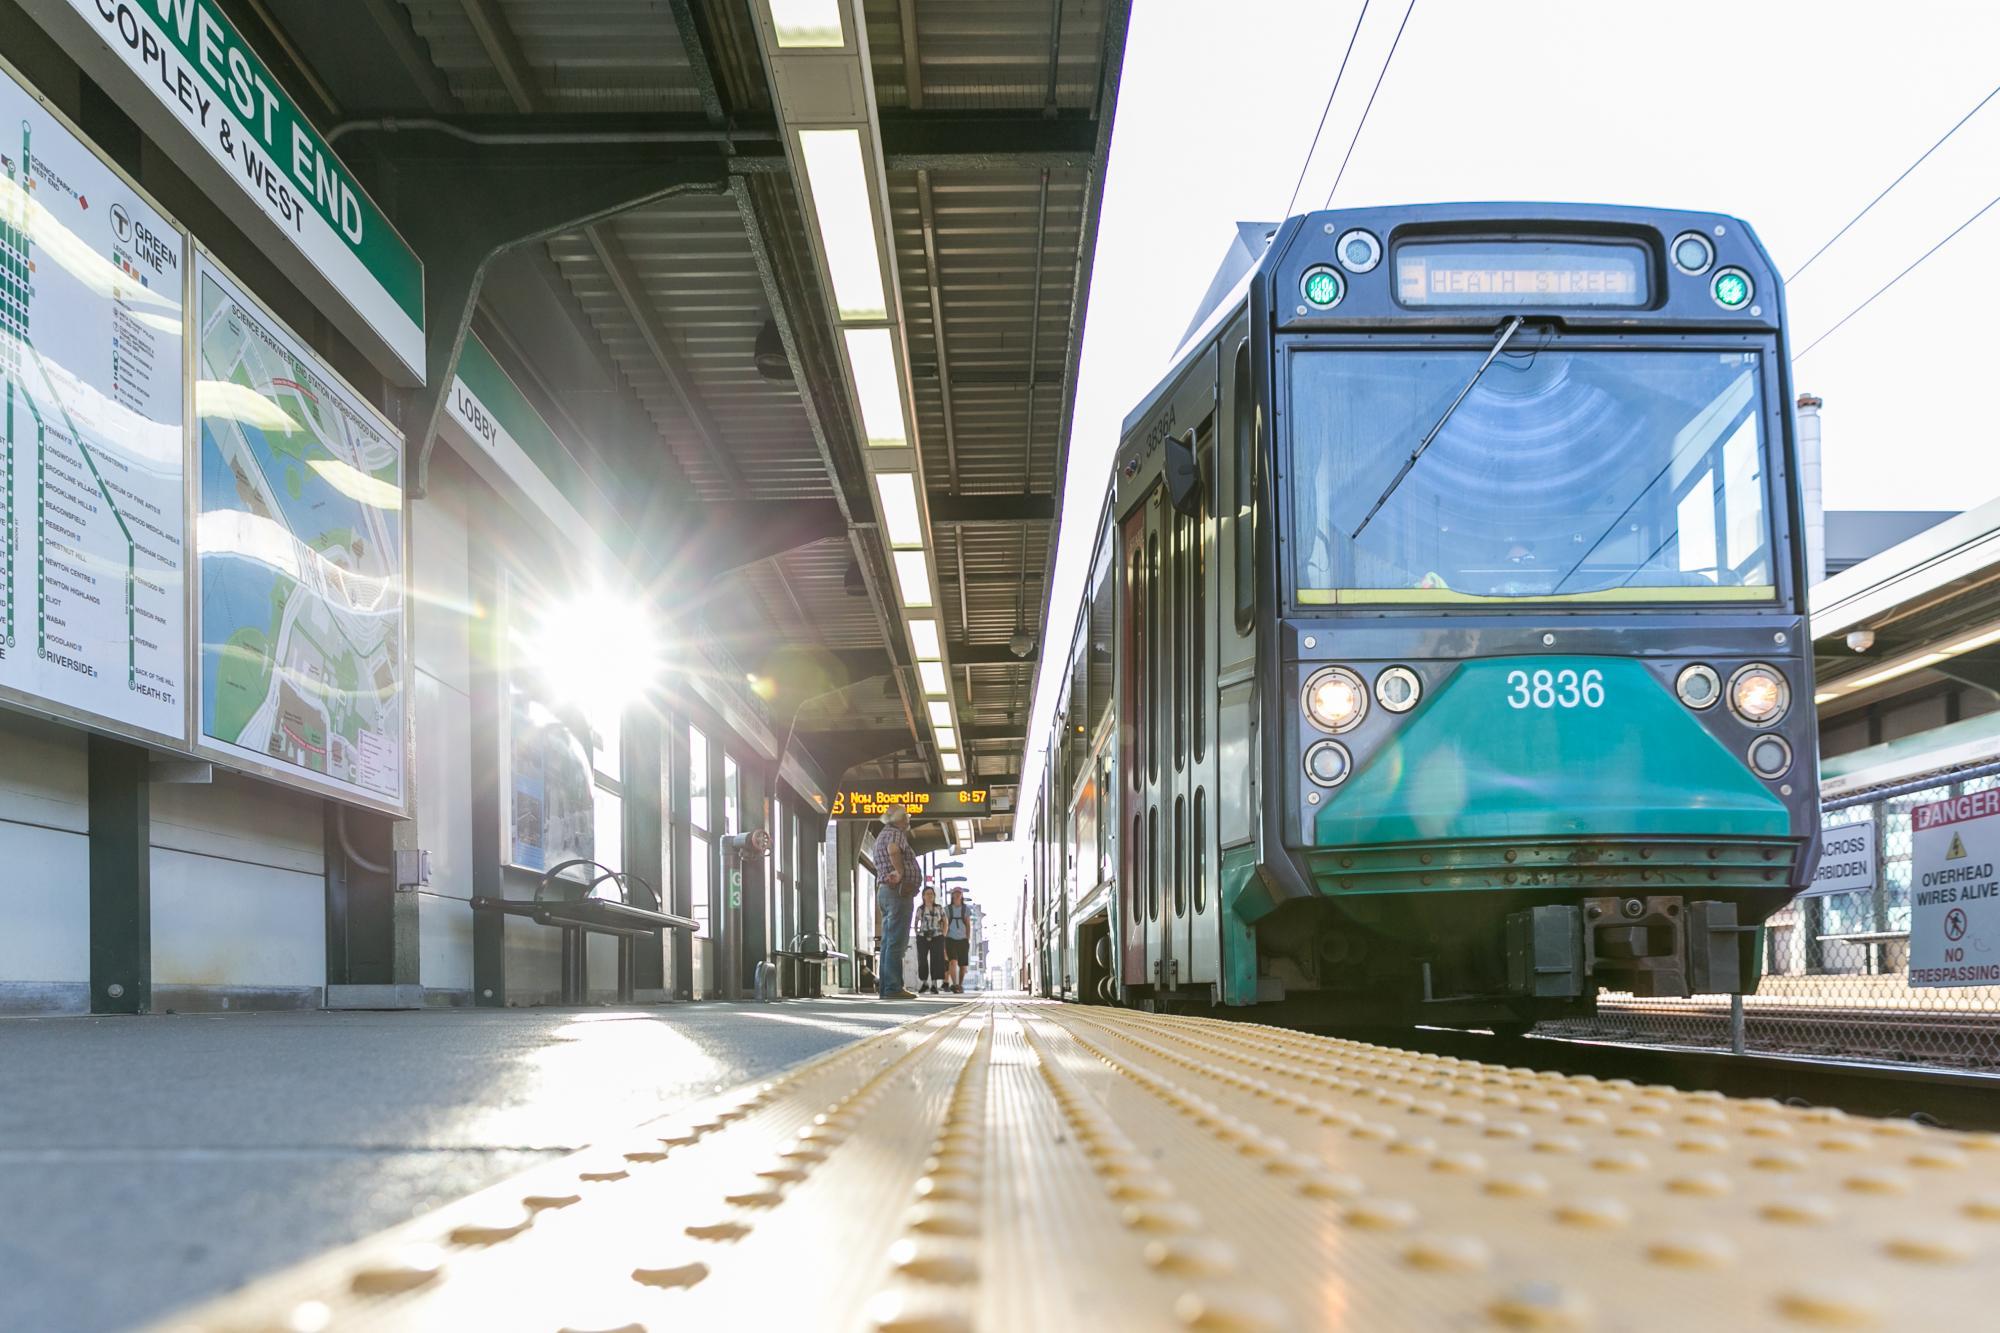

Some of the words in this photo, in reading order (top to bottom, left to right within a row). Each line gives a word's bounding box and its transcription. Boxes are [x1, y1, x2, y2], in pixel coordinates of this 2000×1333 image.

[95, 0, 210, 128] COPLEY
[220, 118, 236, 161] &
[242, 140, 304, 232] WEST
[31, 154, 56, 180] SCIENCE
[31, 165, 47, 182] WEST
[48, 178, 60, 191] END
[292, 120, 362, 245] END
[113, 243, 133, 263] LEGEND
[135, 221, 176, 270] GREEN
[136, 238, 162, 275] LINE
[1432, 271, 1516, 292] HEATH
[231, 304, 259, 337] SCIENCE
[260, 331, 295, 368] PARK/WEST
[295, 364, 308, 380] END
[308, 374, 330, 400] STATION
[330, 395, 369, 435] NEIGHBORHOOD
[370, 431, 380, 444] MAP
[458, 388, 496, 447] LOBBY
[45, 424, 68, 443] FENWAY
[1146, 404, 1176, 458] 3836A
[45, 444, 78, 468] LONGWOOD
[85, 443, 124, 471] NORTHEASTERN
[45, 463, 77, 485] BROOKLINE
[77, 478, 98, 497] VILLAGE
[45, 482, 77, 505] BROOKLINE
[78, 499, 92, 512] HILLS
[45, 501, 86, 526] BEACONSFIELD
[119, 510, 145, 526] LONGWOOD
[45, 520, 76, 540] RESERVOIR
[45, 538, 75, 556] CHESTNUT
[75, 550, 87, 562] HILL
[45, 557, 69, 574] NEWTON
[70, 568, 91, 583] CENTRE
[45, 576, 69, 592] NEWTON
[70, 587, 100, 605] HIGHLANDS
[45, 594, 61, 606] ELIOT
[46, 614, 66, 627] WABAN
[135, 607, 154, 619] MISSION
[155, 615, 166, 625] PARK
[46, 633, 77, 650] WOODLAND
[135, 637, 158, 650] RIVERWAY
[47, 651, 93, 677] RIVERSIDE
[136, 667, 148, 677] BACK
[155, 674, 165, 683] THE
[165, 678, 175, 687] HILL
[1507, 669, 1605, 709] 3836
[136, 684, 161, 700] HEATH
[162, 692, 171, 704] ST
[850, 791, 872, 803] Now
[876, 791, 929, 803] Boarding
[1918, 788, 2000, 829] DANGER
[732, 871, 742, 886] G
[1922, 863, 1993, 887] OVERHEAD
[733, 891, 741, 906] 3
[1917, 887, 1957, 906] WIRES
[1961, 882, 1999, 902] ALIVE
[1945, 948, 1964, 963] NO
[1911, 965, 2000, 984] TRESPASSING
